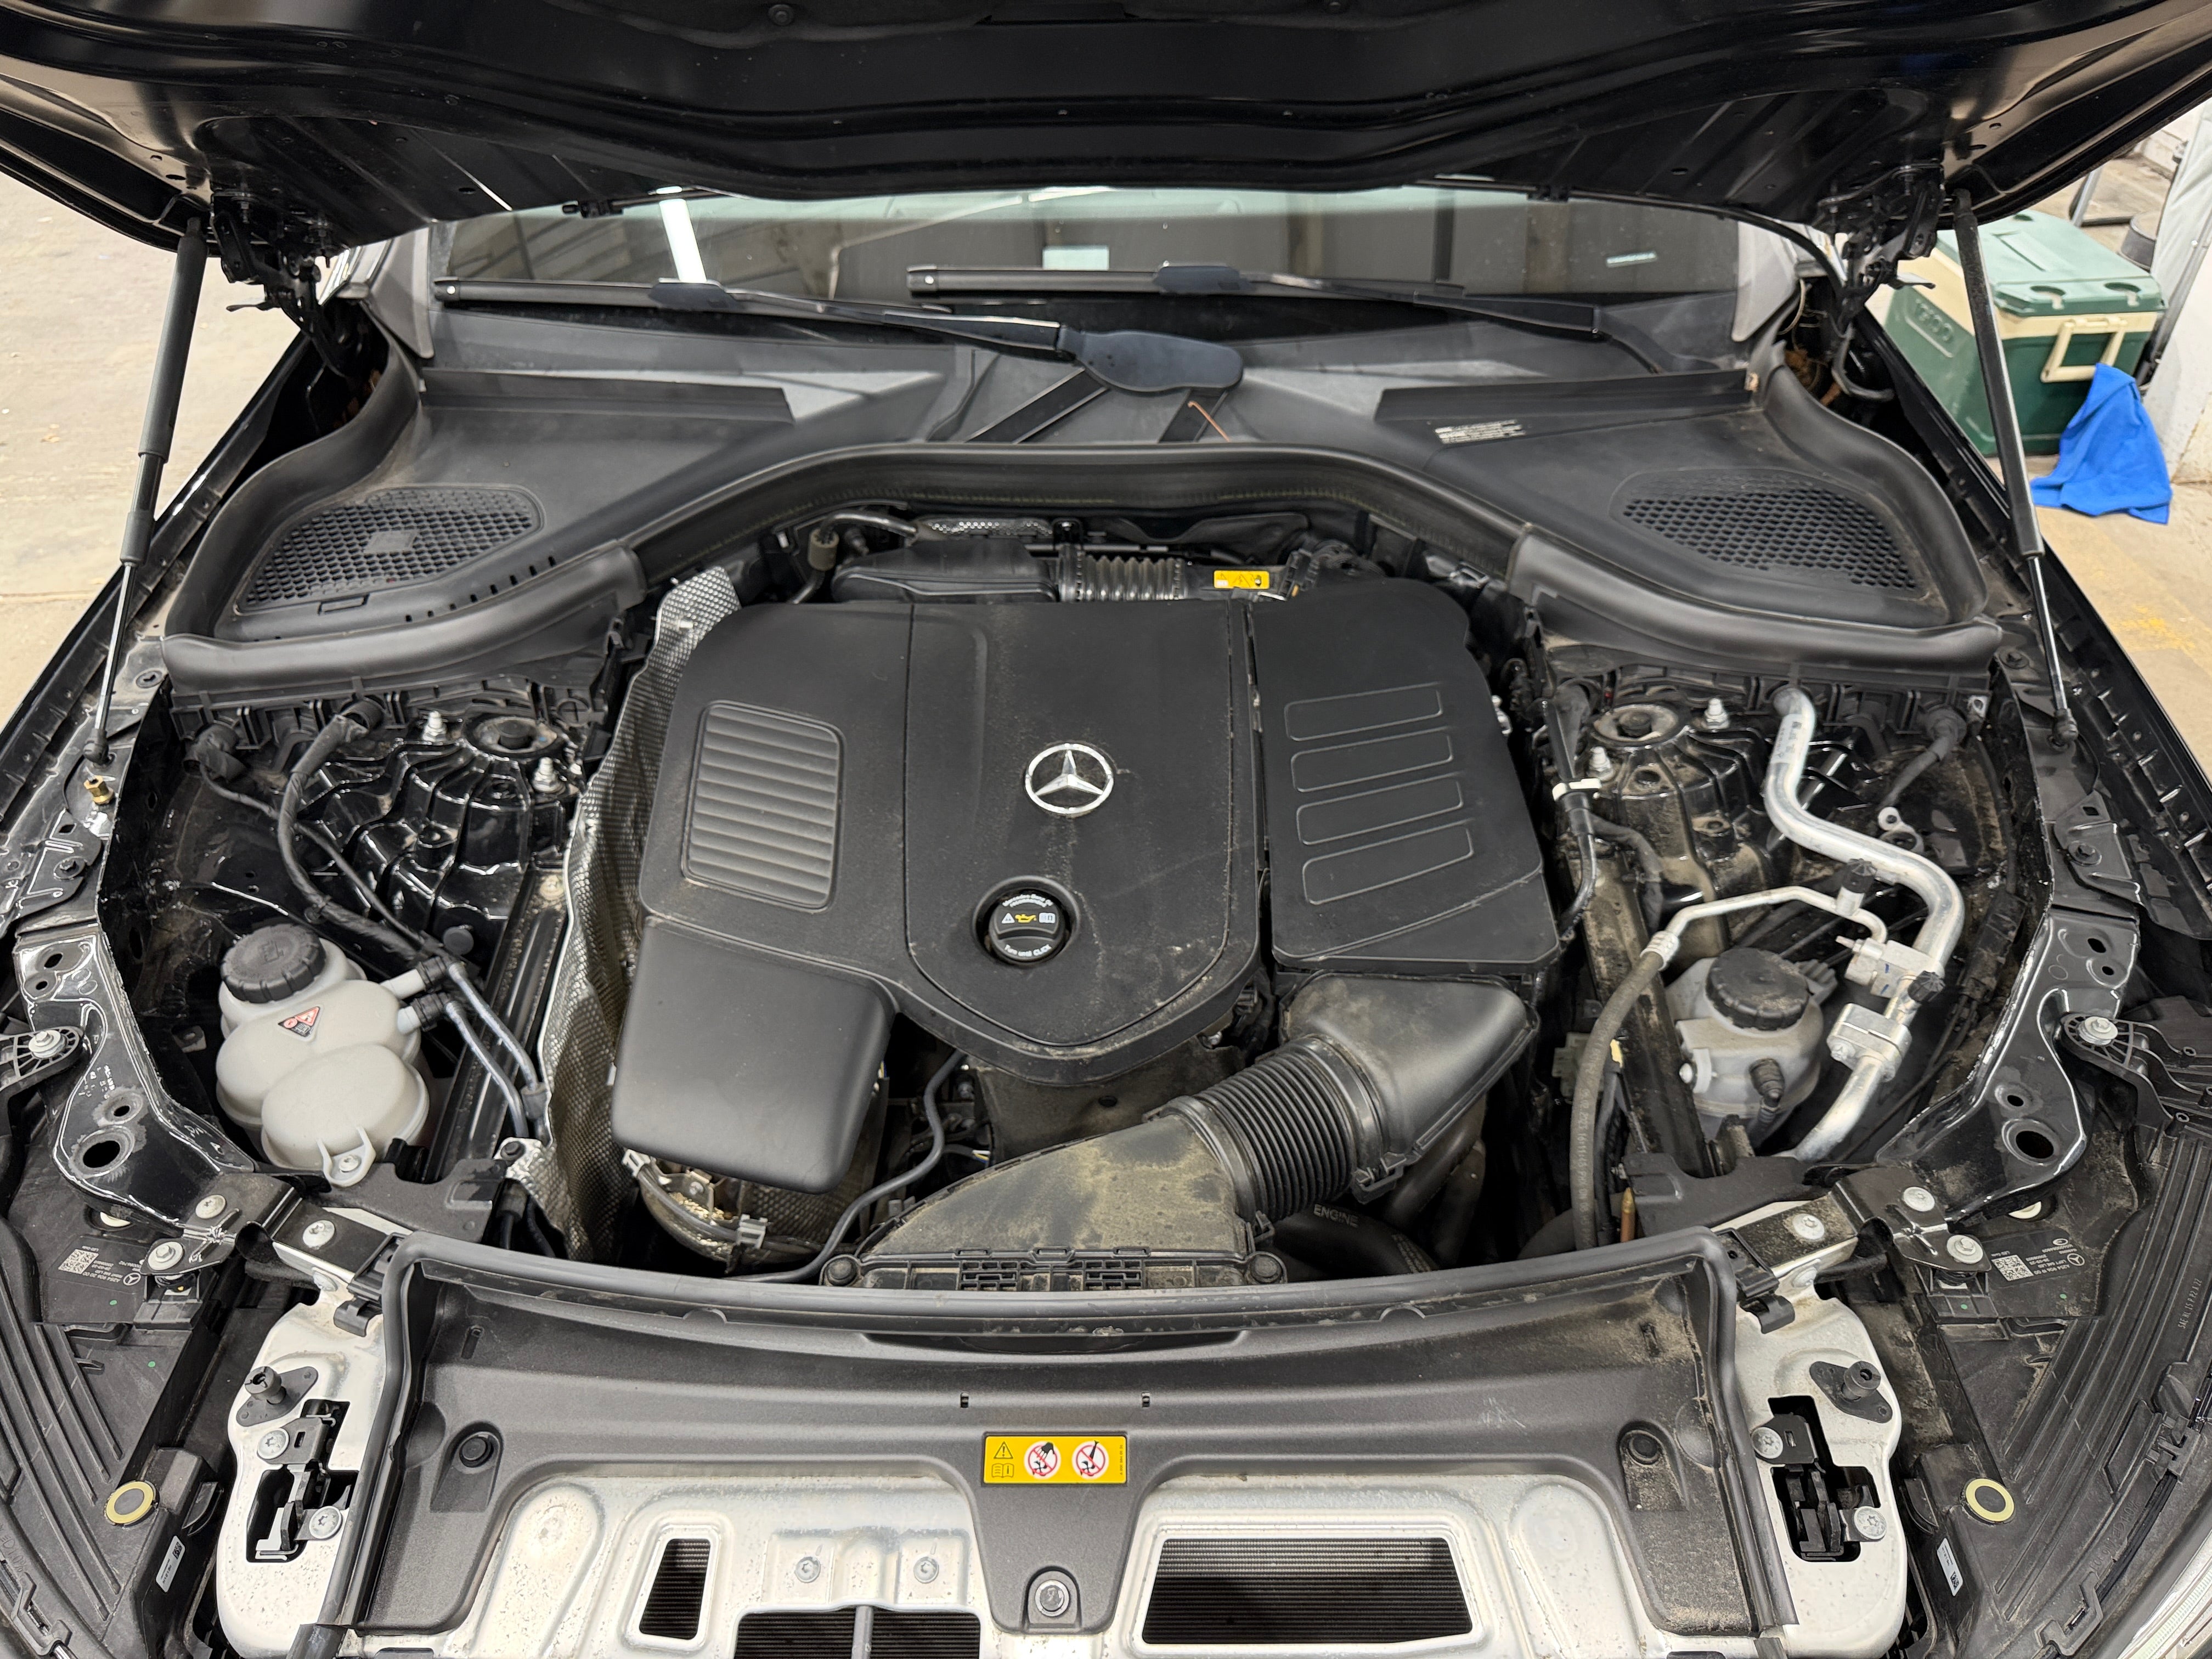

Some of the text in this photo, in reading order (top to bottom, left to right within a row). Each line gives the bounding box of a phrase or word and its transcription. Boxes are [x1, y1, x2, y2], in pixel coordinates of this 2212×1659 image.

[1033, 944, 1052, 956] CLICK
[1313, 1204, 1359, 1228] ENGINE
[2178, 1318, 2189, 1329] SAE
